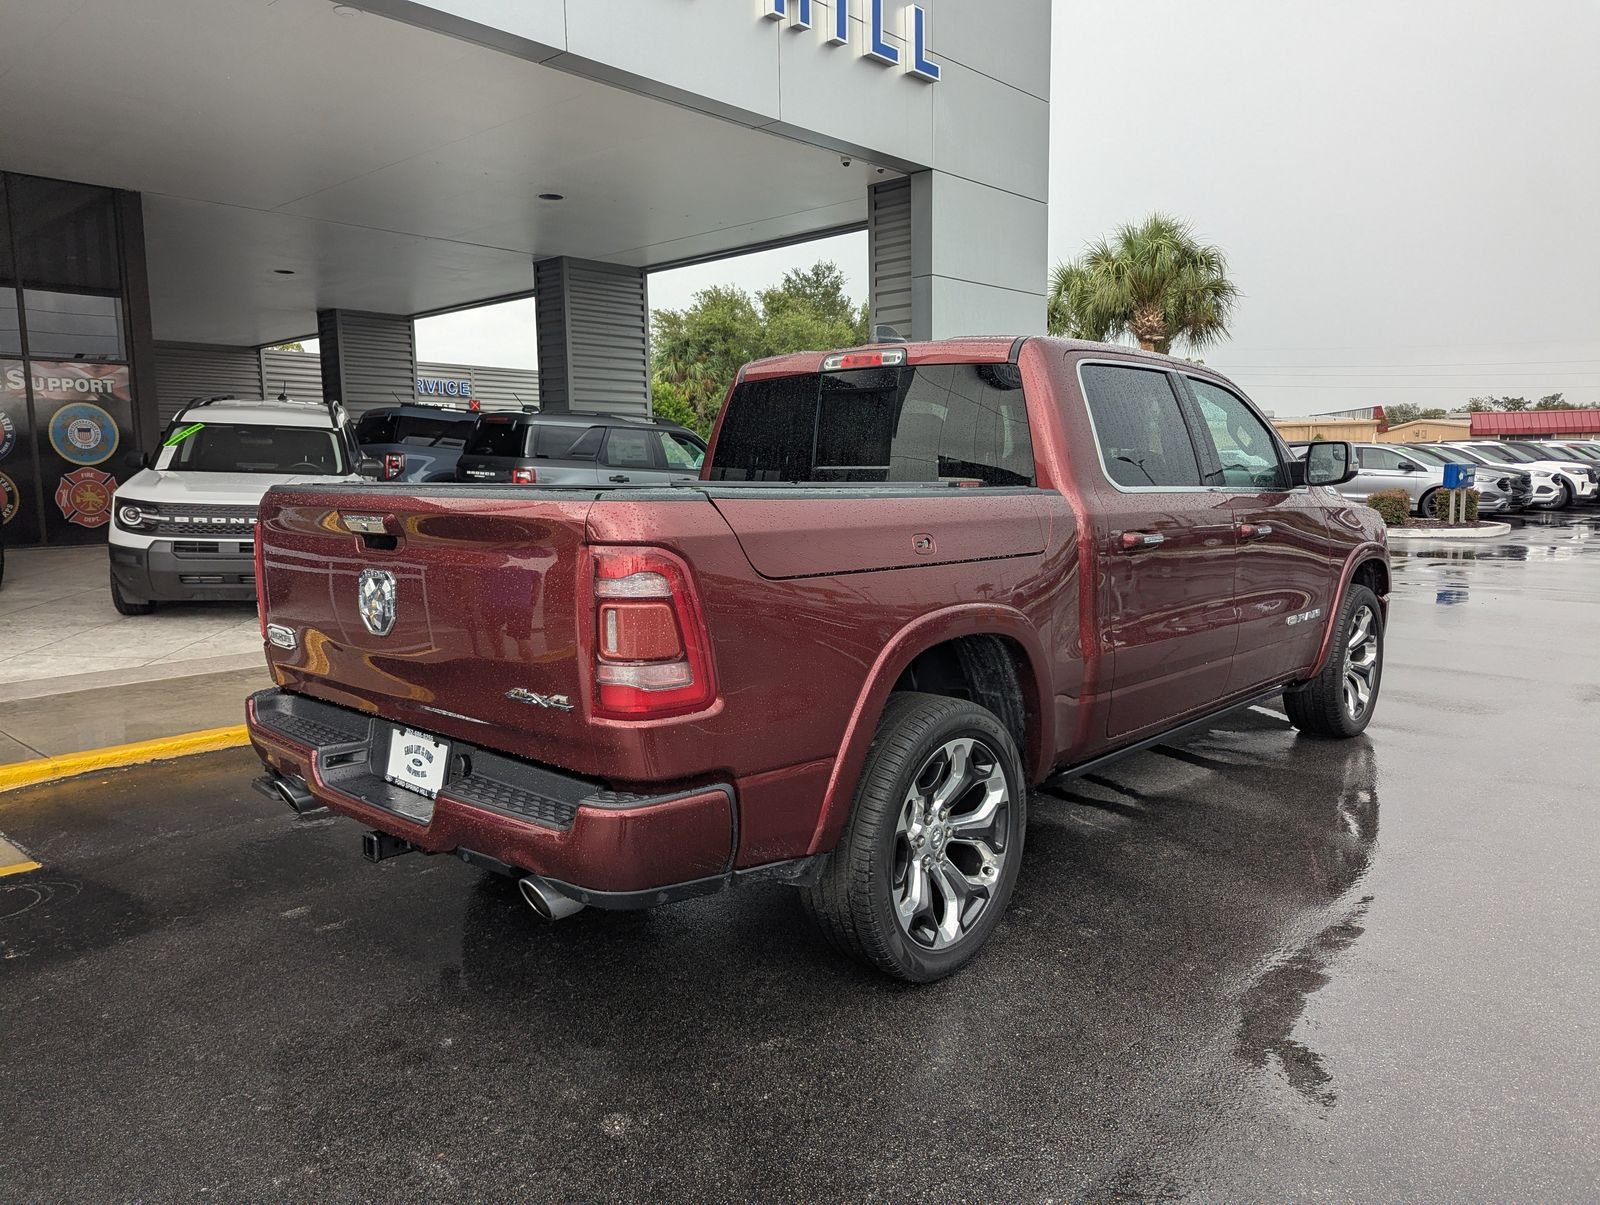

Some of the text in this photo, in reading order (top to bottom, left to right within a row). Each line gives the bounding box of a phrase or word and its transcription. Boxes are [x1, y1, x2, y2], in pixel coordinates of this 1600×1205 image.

[6, 369, 116, 393] SUPPORT
[417, 378, 471, 396] RVICE
[174, 516, 258, 524] BRONC
